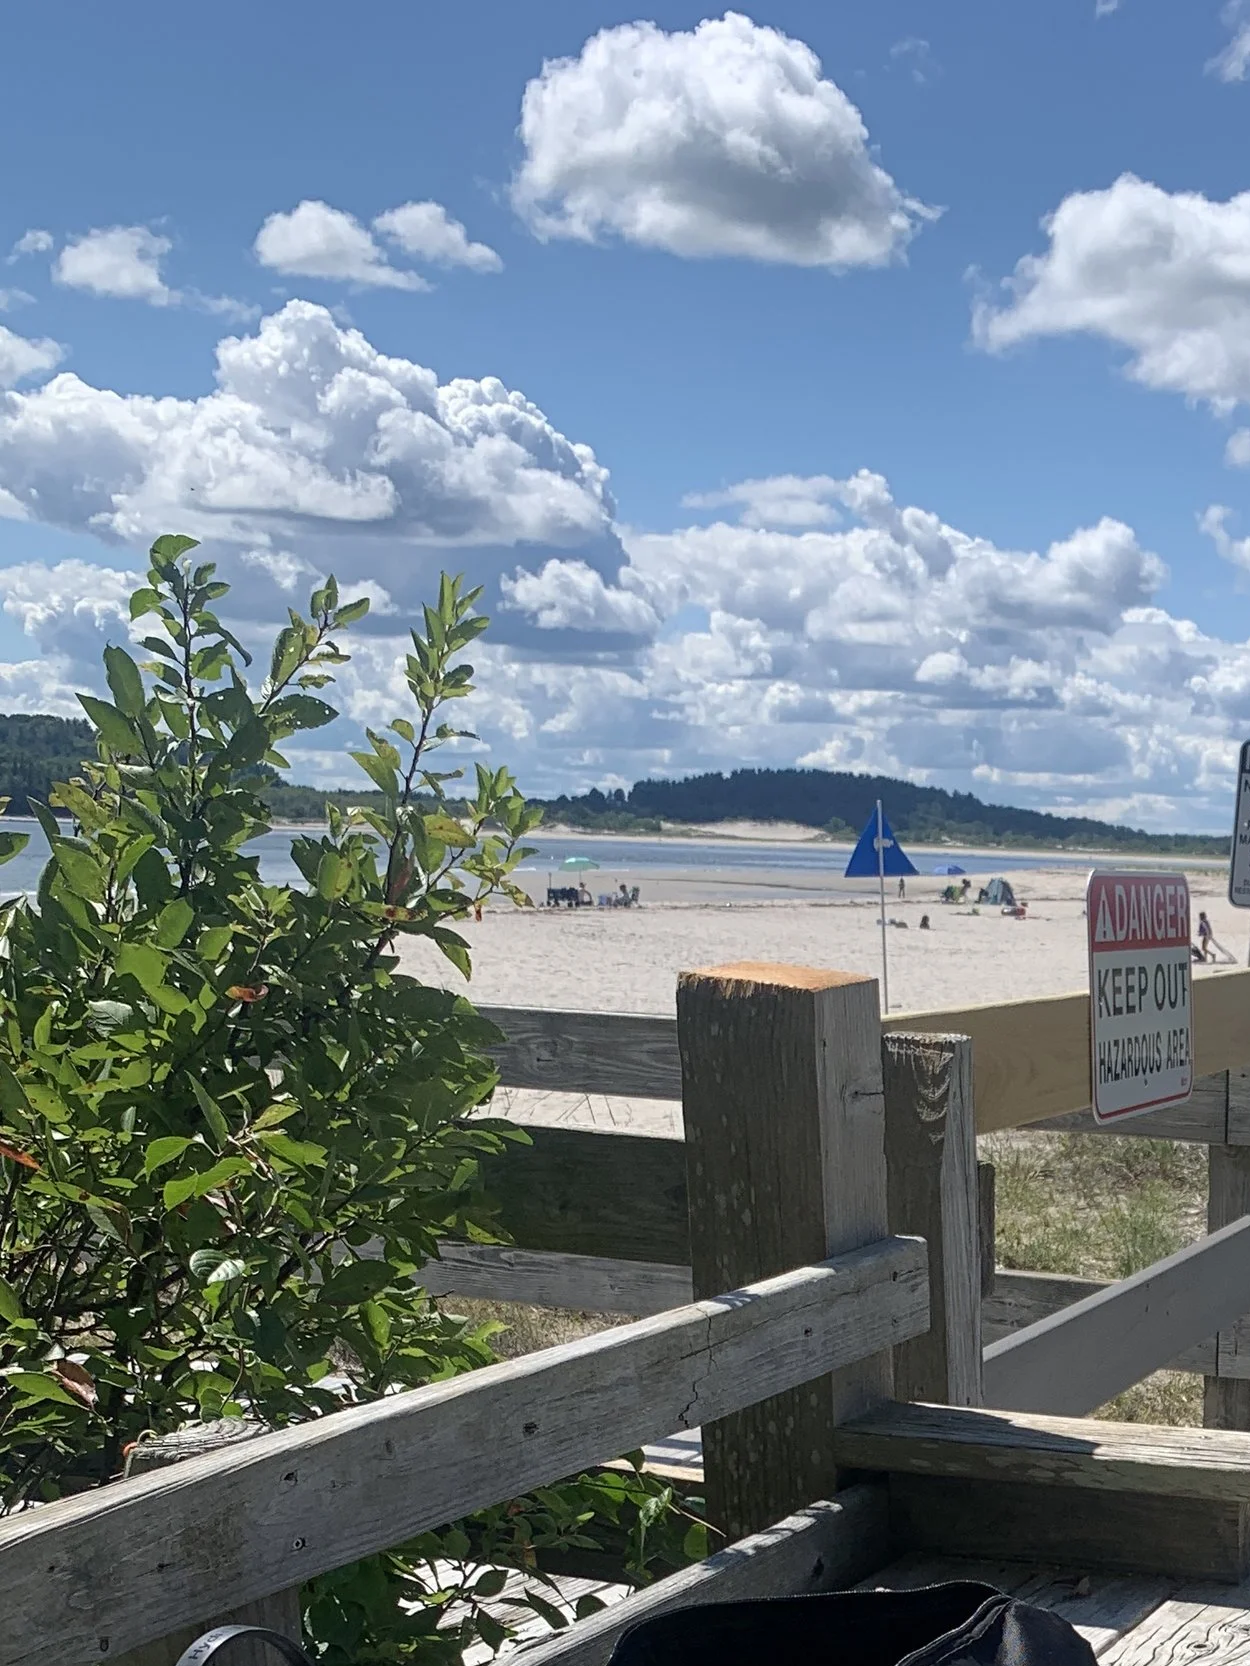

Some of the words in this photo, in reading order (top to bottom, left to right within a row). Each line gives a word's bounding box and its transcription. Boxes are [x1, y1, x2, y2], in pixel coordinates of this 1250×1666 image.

[1115, 884, 1188, 943] DANGER
[1098, 965, 1149, 1018] KEEP
[1154, 961, 1188, 1012] OUT
[1098, 1033, 1162, 1084] HAZARDOUS
[1166, 1027, 1191, 1070] AREA
